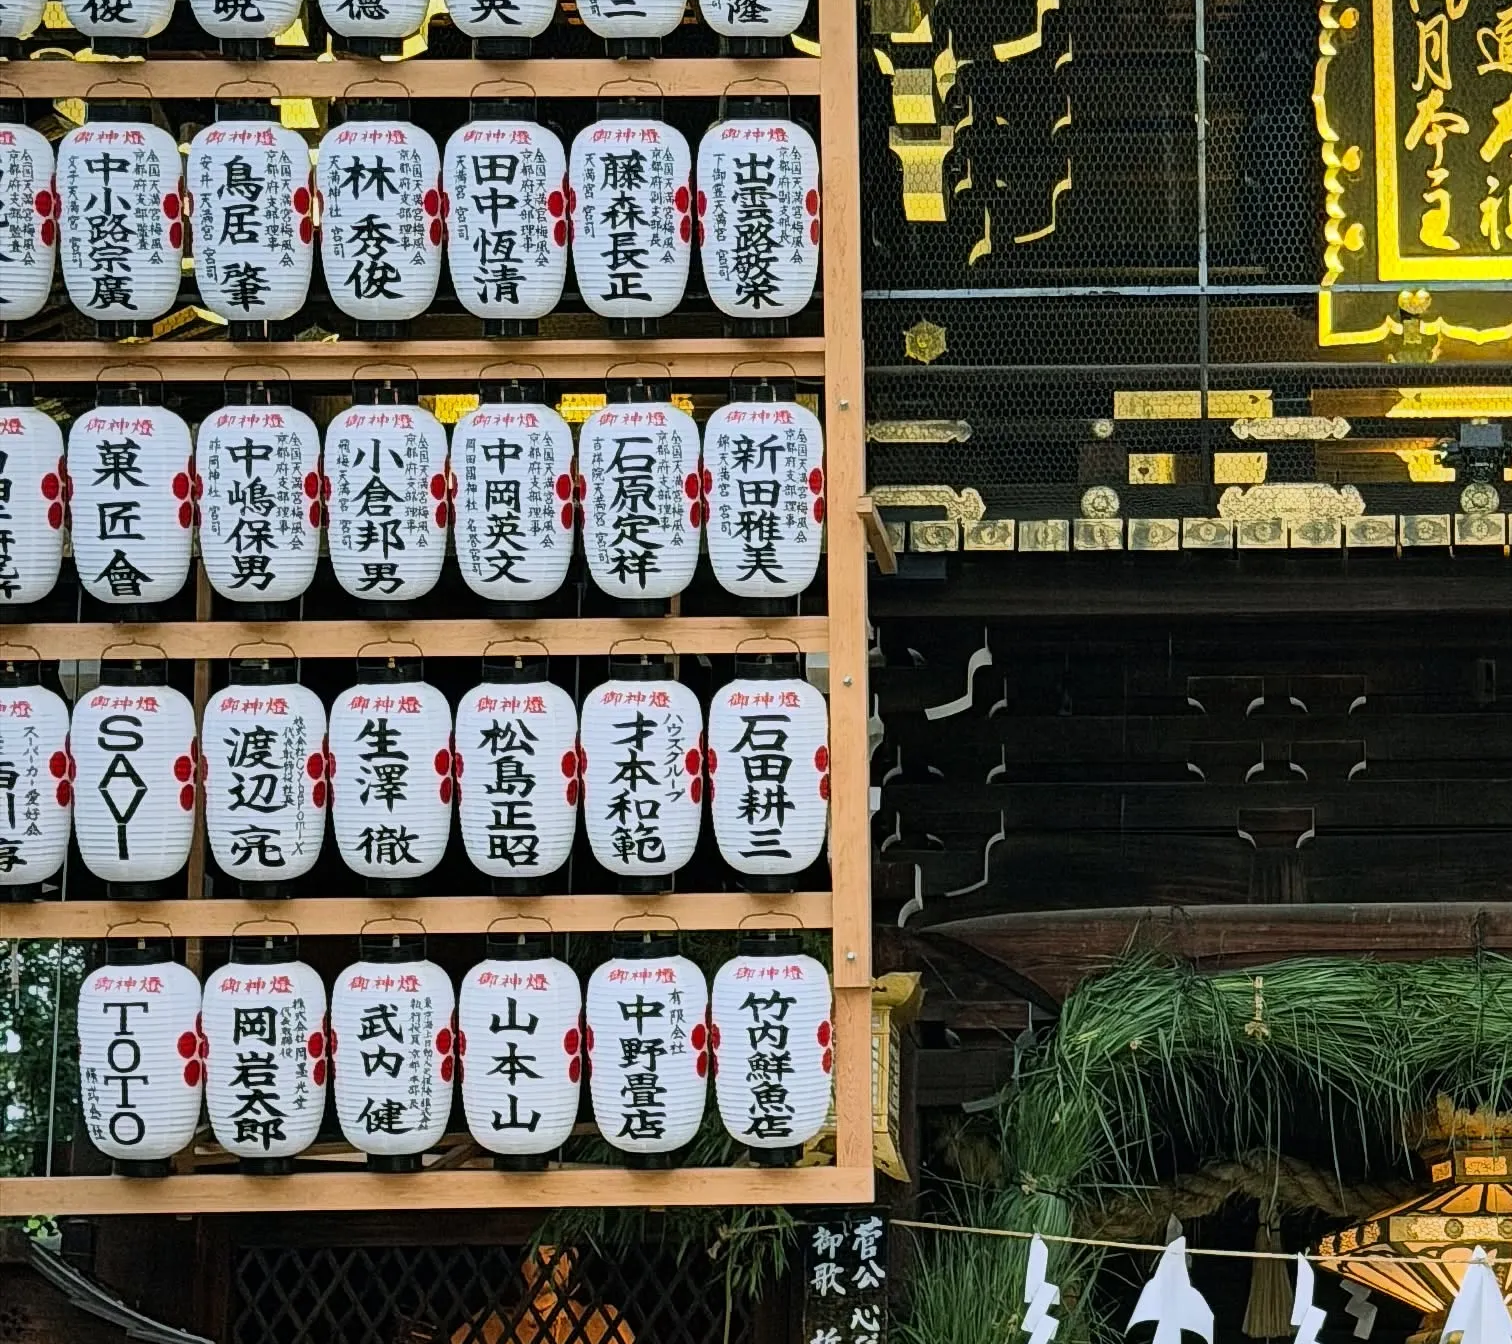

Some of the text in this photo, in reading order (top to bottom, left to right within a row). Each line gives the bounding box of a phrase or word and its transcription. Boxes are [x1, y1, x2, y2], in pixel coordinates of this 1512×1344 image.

[600, 150, 652, 301] 藤森長正
[731, 153, 788, 309] 出雲路敬栄
[93, 438, 153, 596] 菓匠會
[225, 438, 277, 590] 中嶋保男
[353, 439, 405, 594] 小倉邦男
[482, 438, 530, 583] 中岡英文
[606, 437, 663, 589] 石原定祥
[732, 435, 787, 583] 新田雅美
[479, 719, 539, 867] 松島正昭
[605, 712, 666, 864] 才本和範
[730, 715, 795, 858] 石田耕三
[103, 1002, 148, 1145] TOTO
[229, 1006, 292, 1150] 岡岩太郎
[488, 998, 541, 1132] 山本山
[617, 995, 667, 1140] 中野畳店
[668, 988, 687, 1055] 有限会社
[740, 990, 796, 1139] 竹内鮮魚店
